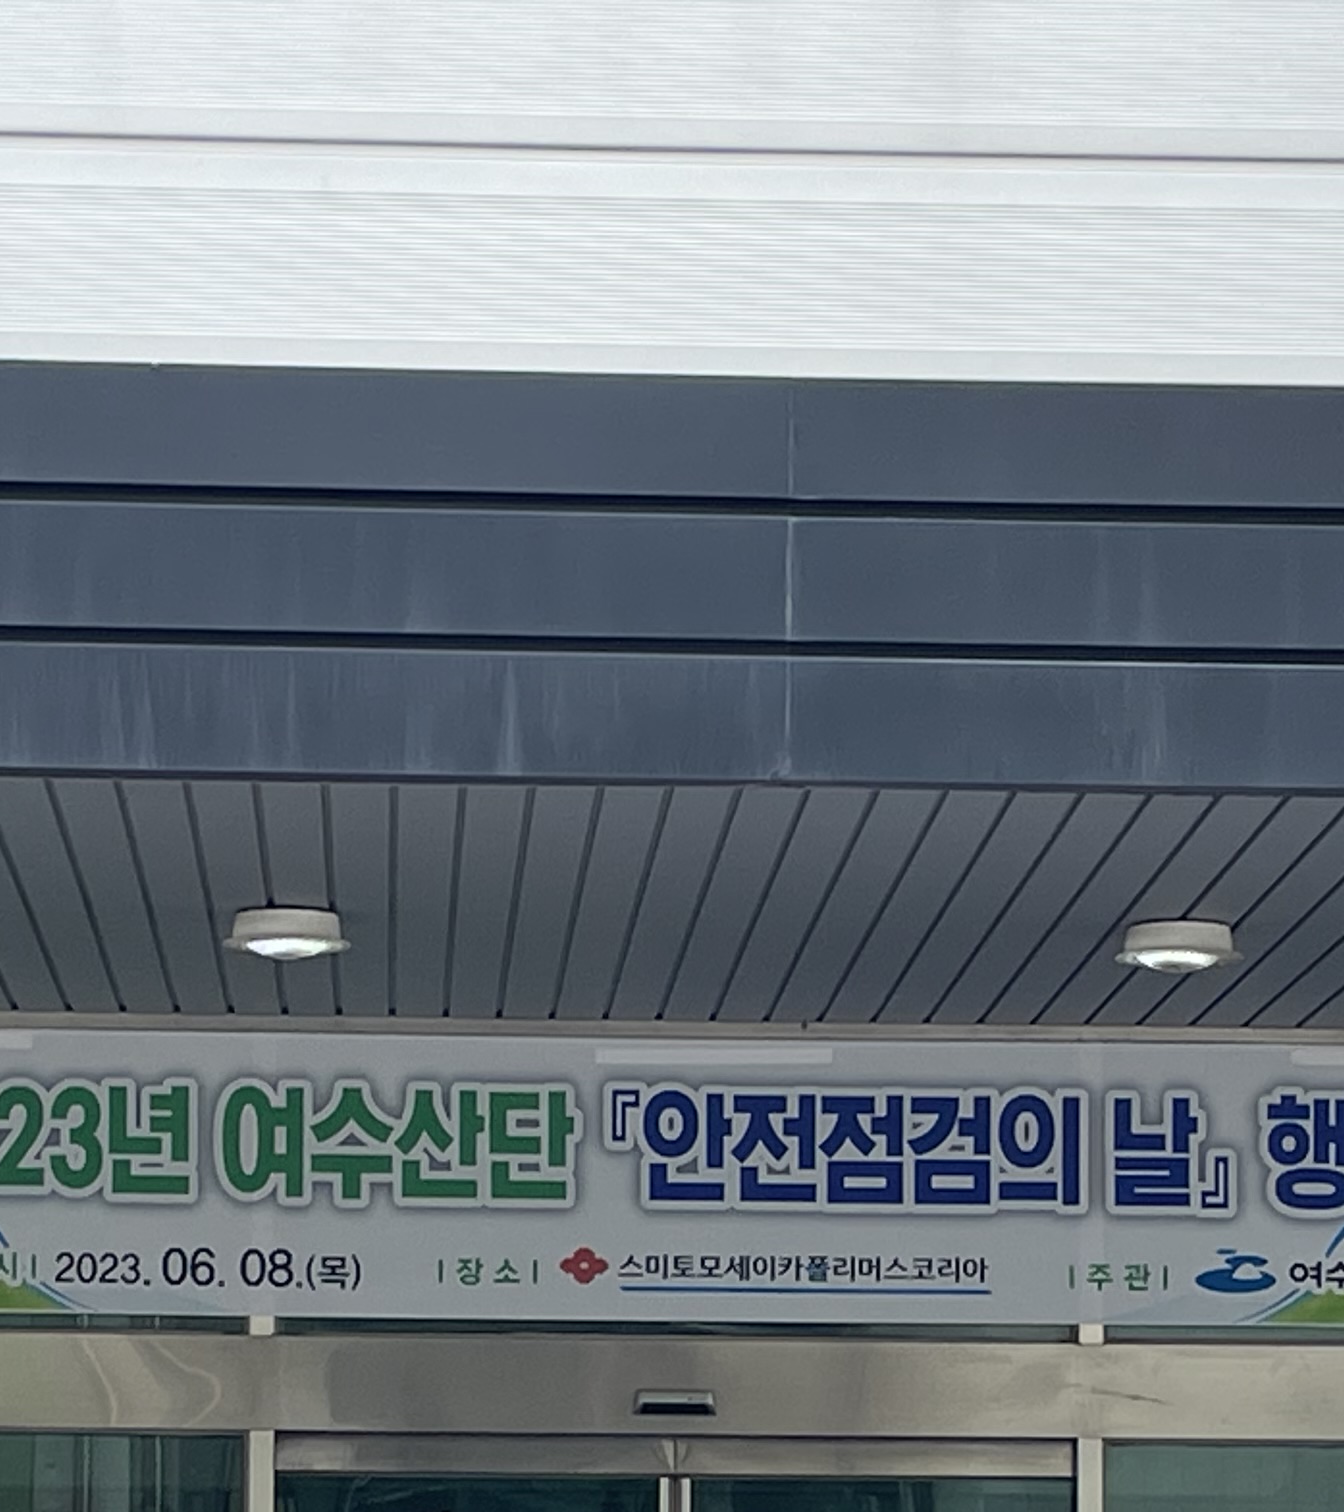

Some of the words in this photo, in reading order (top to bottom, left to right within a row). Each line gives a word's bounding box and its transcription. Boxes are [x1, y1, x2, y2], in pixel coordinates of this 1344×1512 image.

[224, 1086, 575, 1200] 여수산단
[57, 1252, 151, 1284] 2023.
[162, 1248, 226, 1287] 06.
